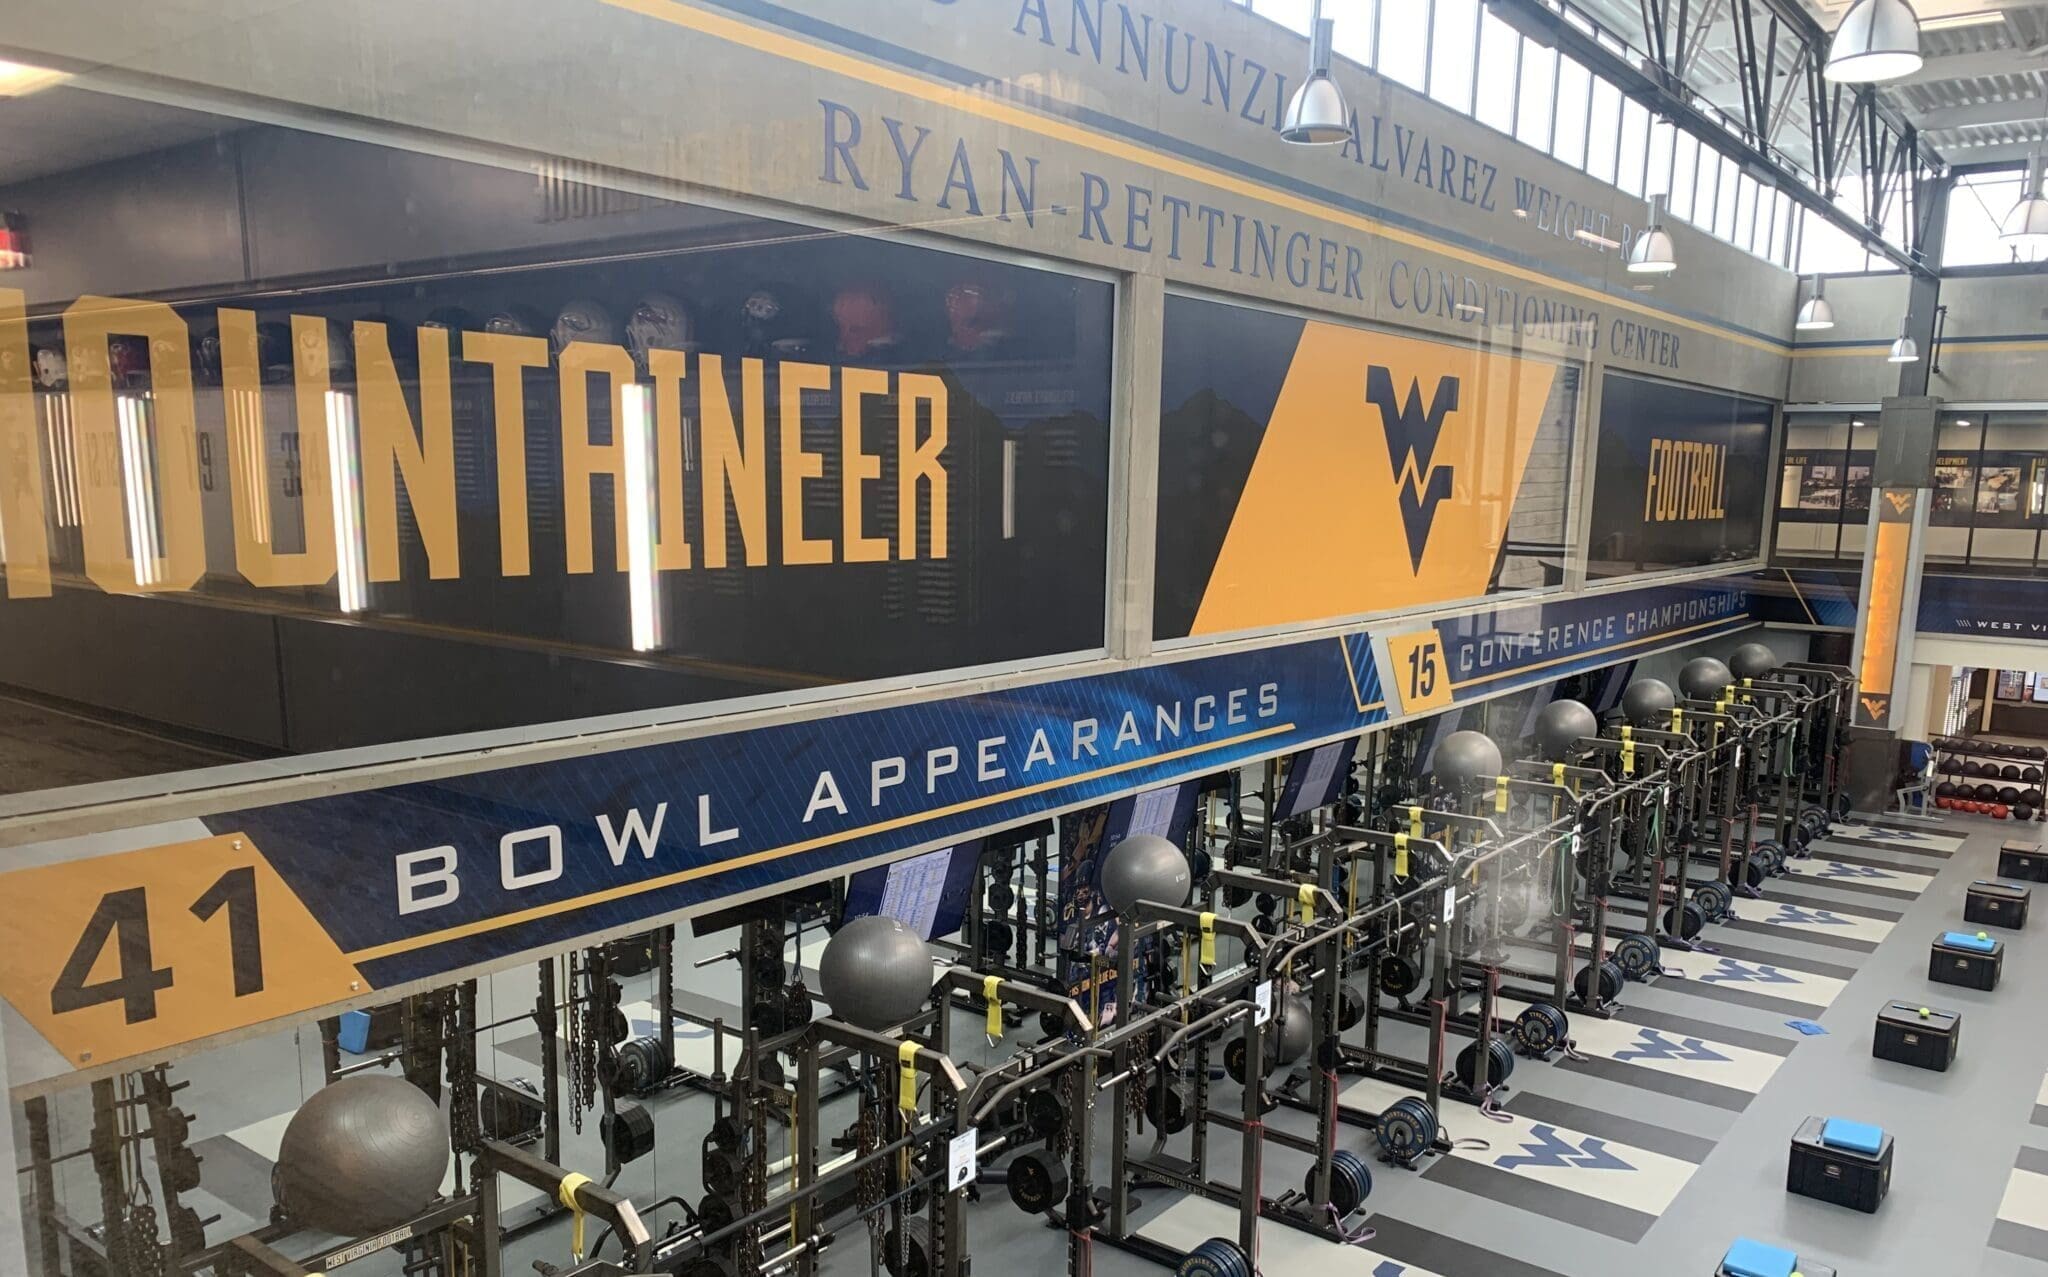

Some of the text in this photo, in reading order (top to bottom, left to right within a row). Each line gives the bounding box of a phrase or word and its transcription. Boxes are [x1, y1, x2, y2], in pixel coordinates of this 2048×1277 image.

[1011, 0, 1289, 132] ANNUNZI
[1341, 107, 1498, 212] ALVAREZ
[1514, 177, 1610, 253] WEIGHT
[817, 98, 1681, 368] RYAN-RETTINGER CONDITIONING CENTER
[1644, 438, 1727, 522] FOOTBALL
[1408, 643, 1437, 702] 15
[1459, 589, 1748, 672] CONFERENCE CHAMPIONSHIPS
[1977, 619, 2024, 631] WEST
[395, 794, 740, 916] BOWL
[802, 682, 1279, 823] APPEARANCES
[51, 865, 264, 1026] 41
